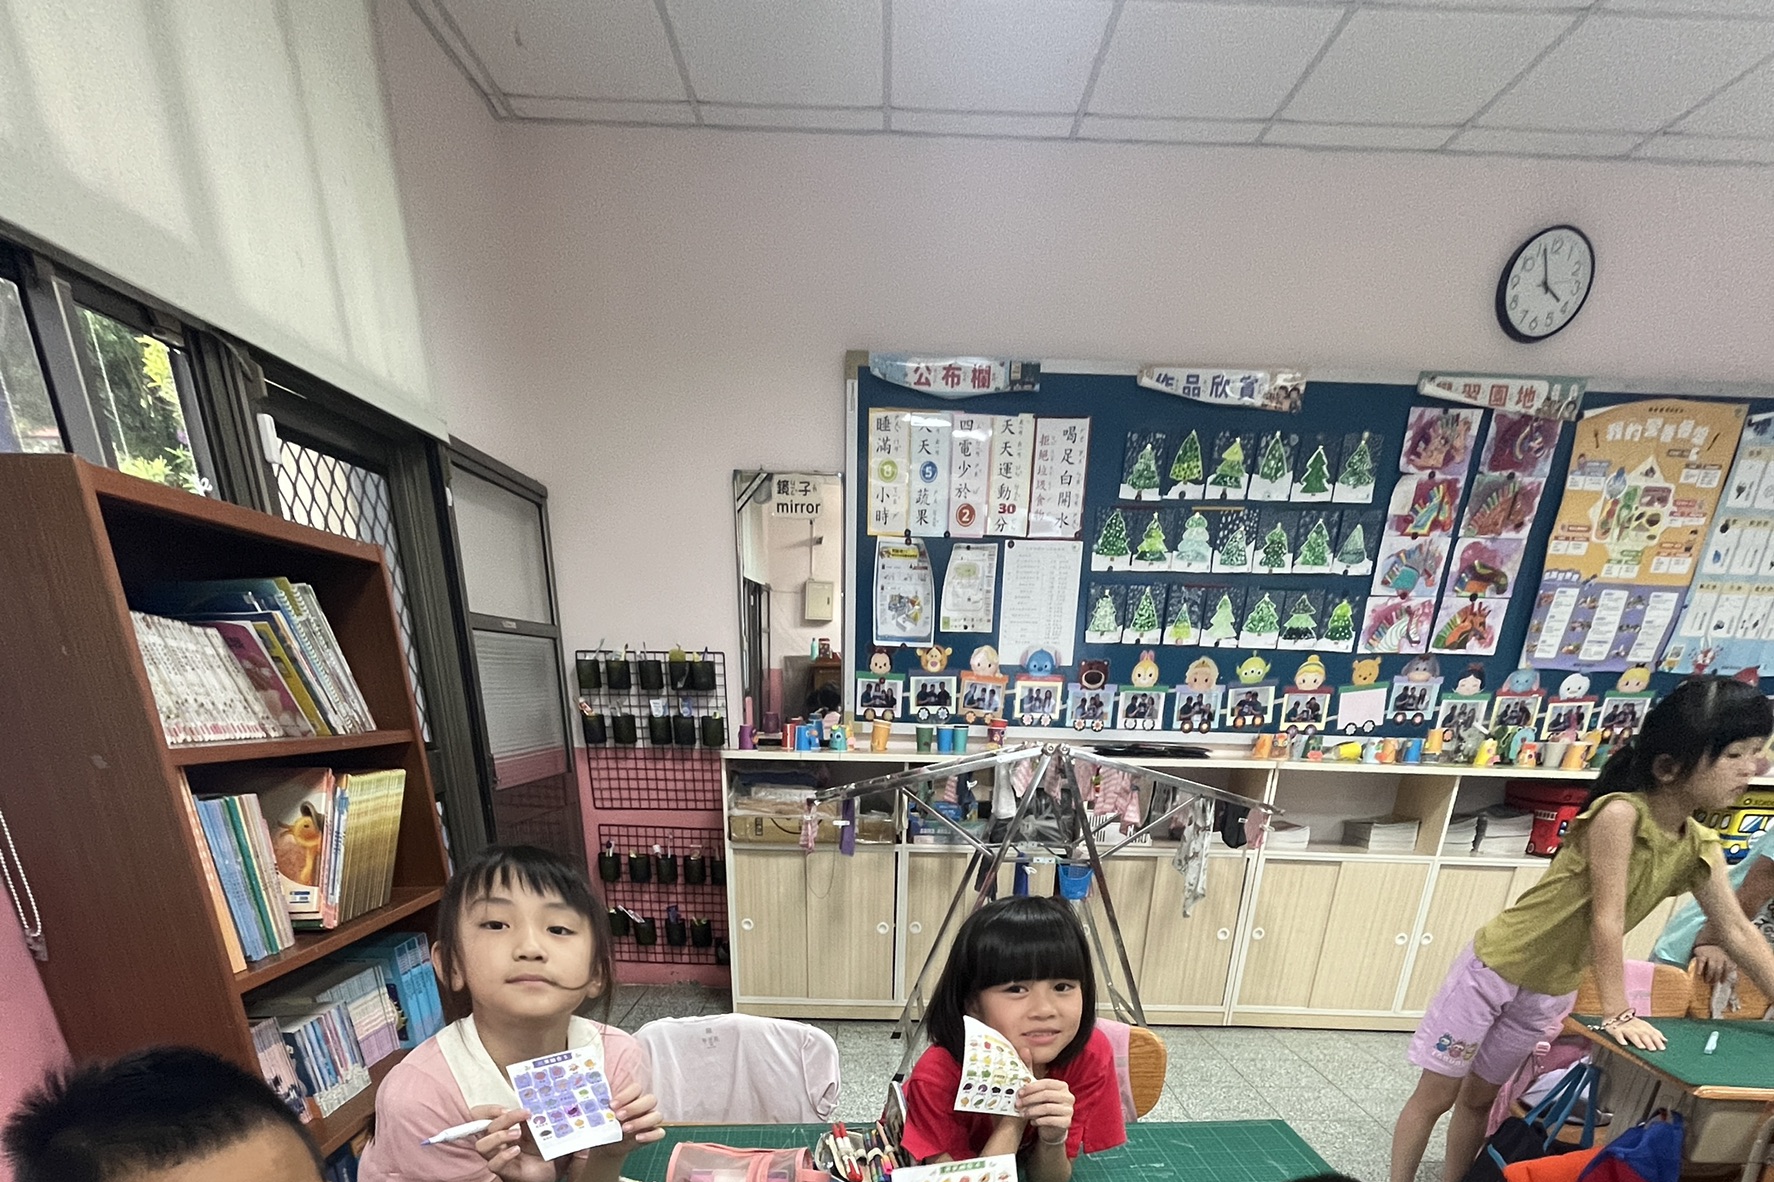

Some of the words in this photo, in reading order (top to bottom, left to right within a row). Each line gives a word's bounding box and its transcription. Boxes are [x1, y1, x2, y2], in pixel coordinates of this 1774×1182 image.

[1552, 238, 1565, 254] 12
[1567, 246, 1574, 261] 1
[1522, 256, 1535, 272] 10
[1571, 261, 1582, 277] 2
[1511, 274, 1521, 290] 9
[1570, 280, 1581, 296] 3
[1509, 294, 1519, 310] 8
[1560, 301, 1569, 315] 4
[1519, 310, 1529, 325] 7
[1529, 316, 1538, 331] 6
[1545, 312, 1554, 327] 5
[914, 363, 991, 389] 公布欄
[1156, 373, 1258, 401] 作品欣賞
[1054, 425, 1077, 529] 喝足白開水
[777, 480, 811, 496] 鏡子
[776, 501, 821, 514] mirror
